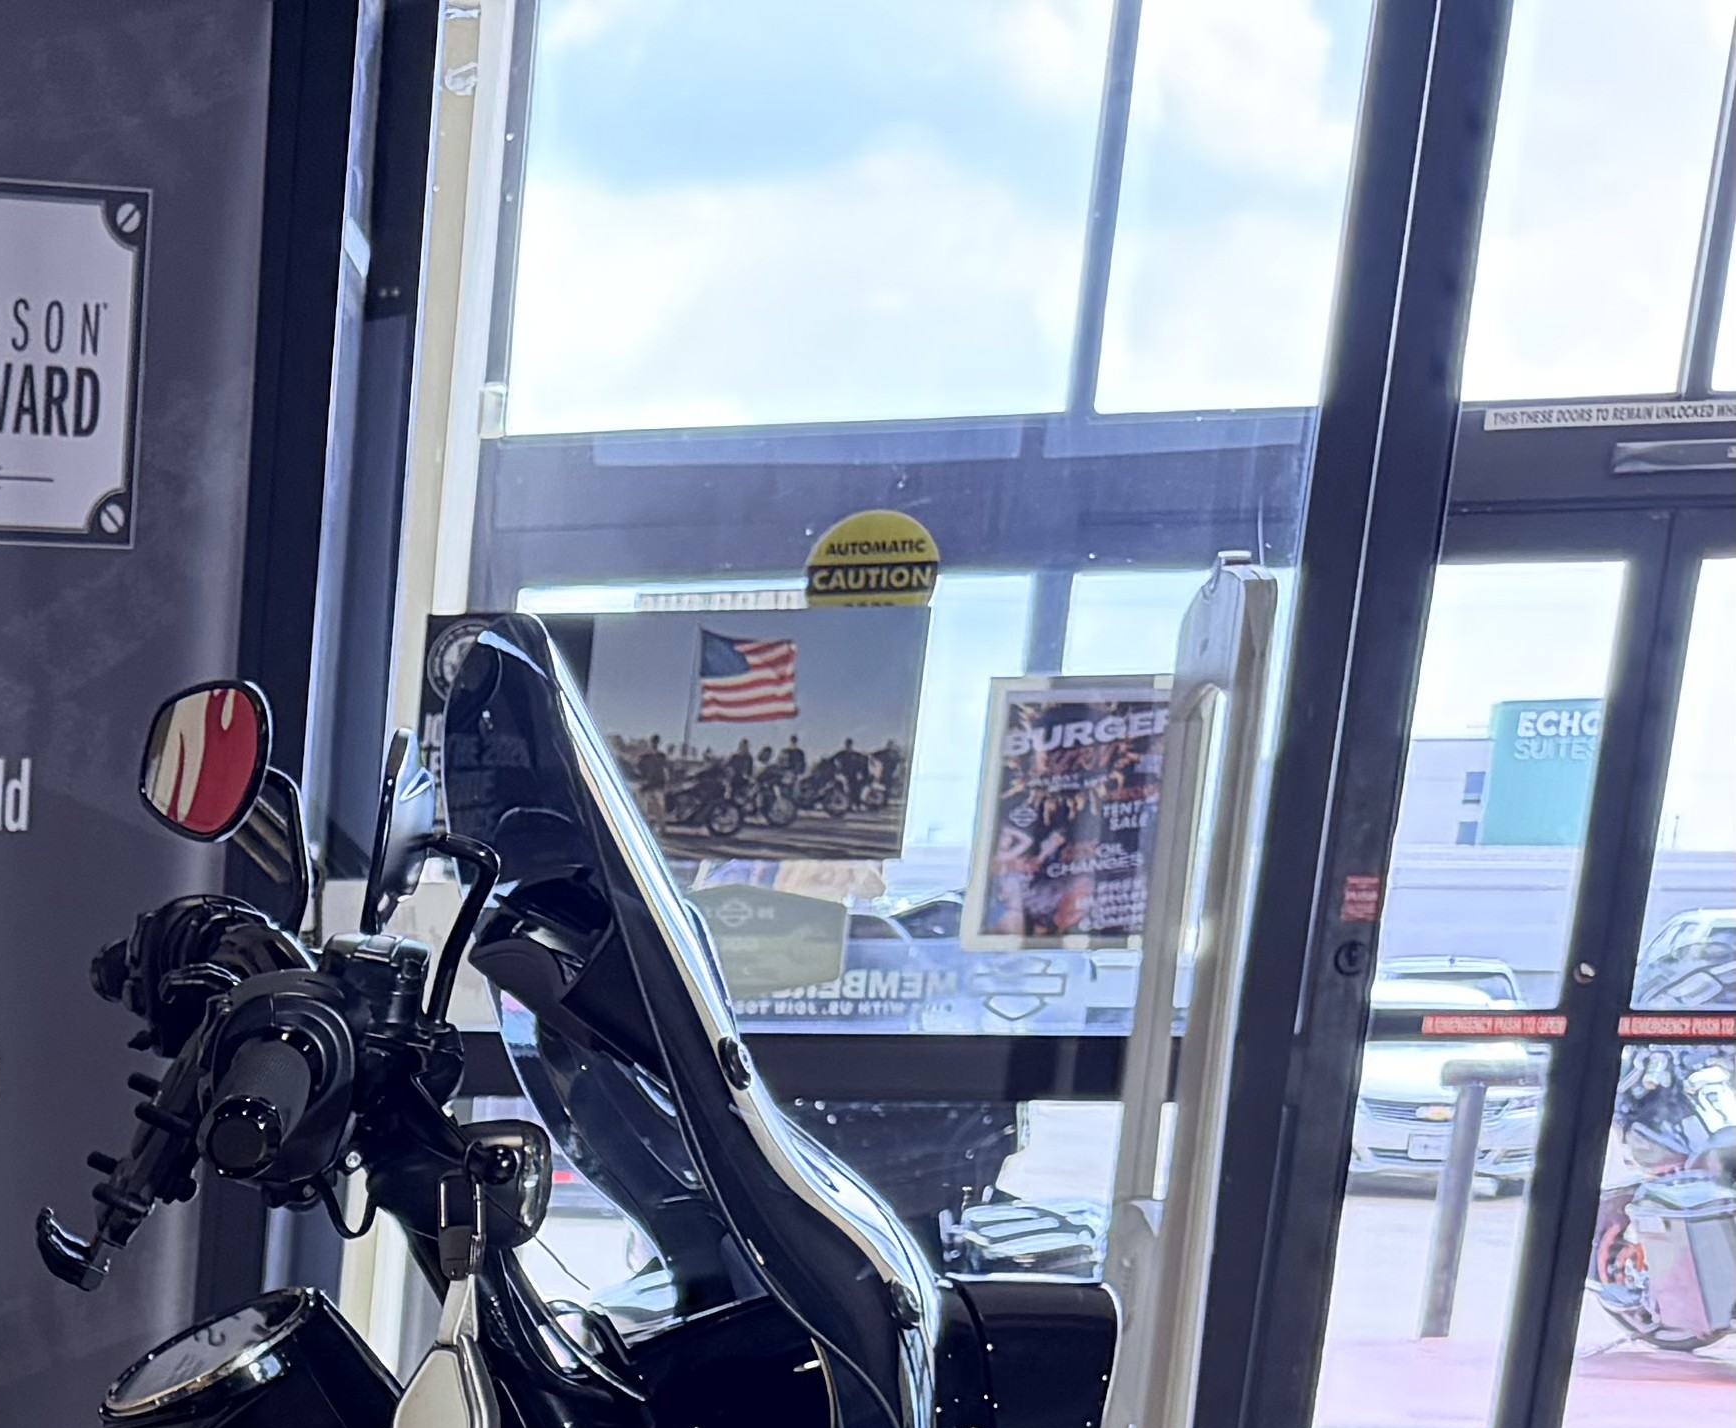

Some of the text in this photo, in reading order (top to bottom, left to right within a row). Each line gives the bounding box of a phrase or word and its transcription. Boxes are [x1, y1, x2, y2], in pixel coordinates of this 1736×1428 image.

[1596, 408, 1609, 421] TO
[1612, 406, 1653, 421] REMAIN
[1655, 404, 1714, 420] UNLOCKED
[826, 538, 927, 556] AUTOMATIC
[812, 565, 933, 592] CAUTION
[1045, 852, 1145, 878] CHANGES
